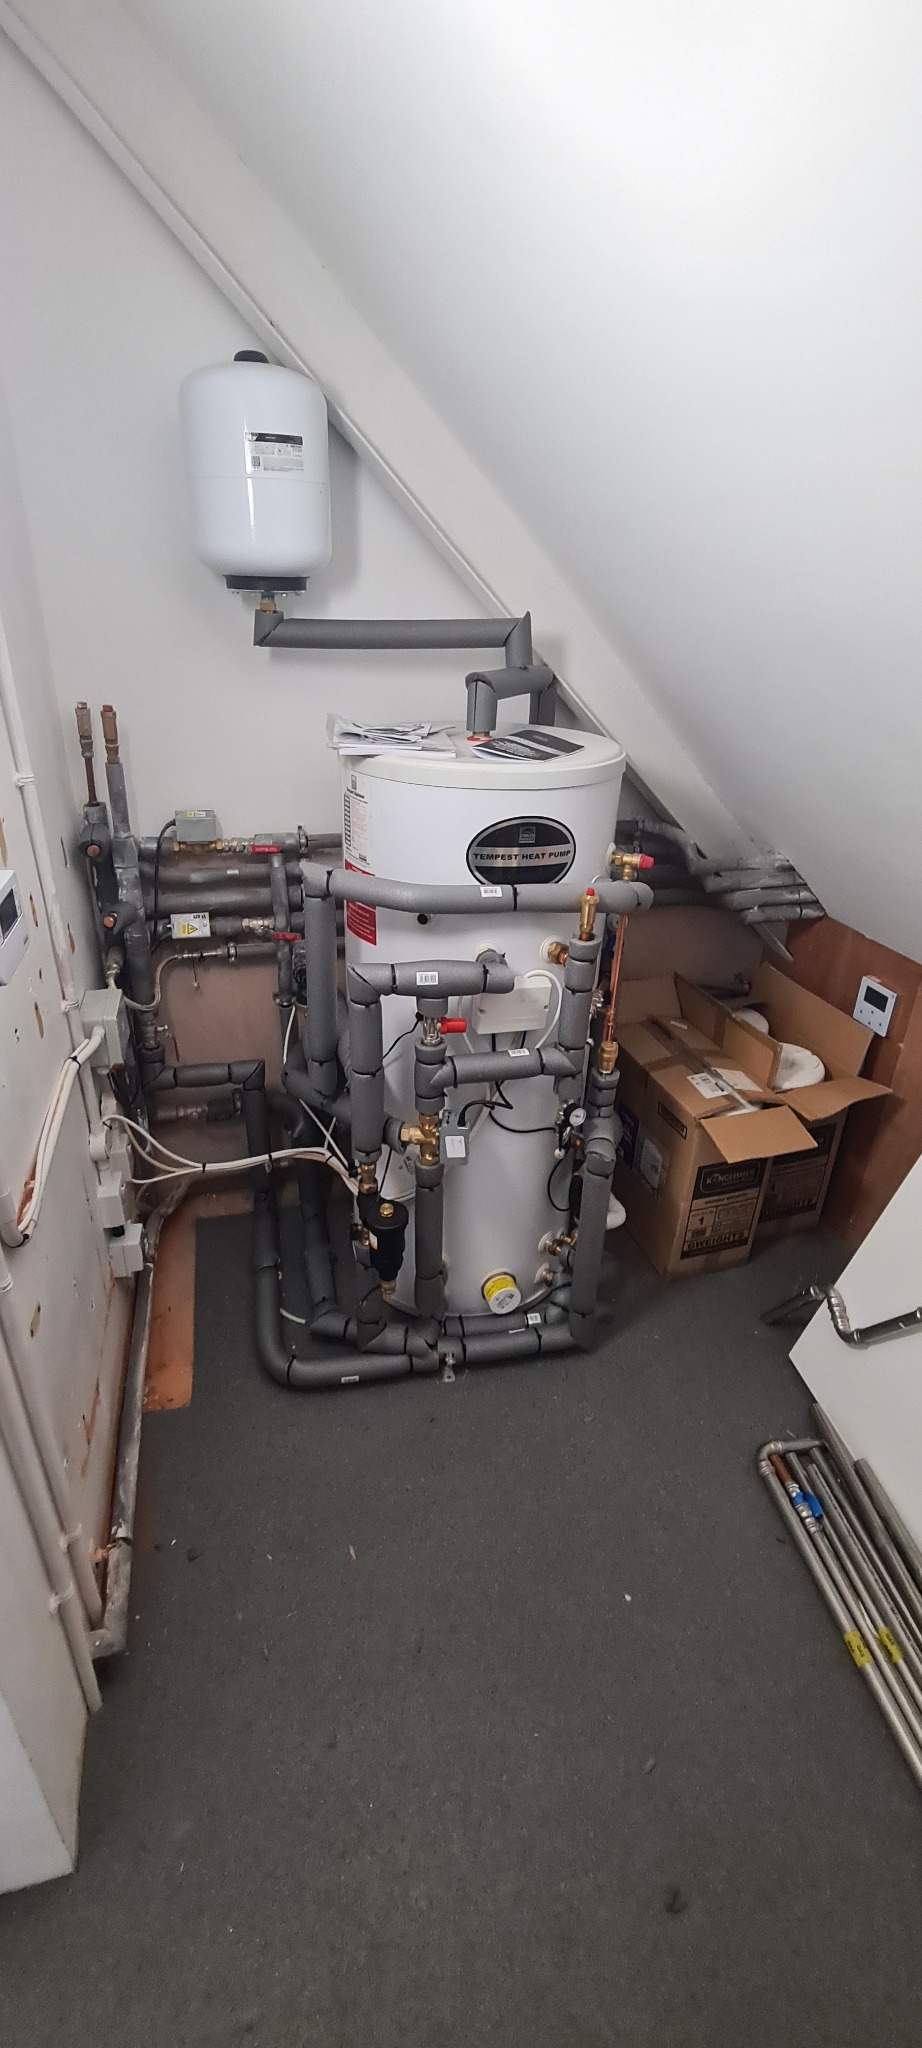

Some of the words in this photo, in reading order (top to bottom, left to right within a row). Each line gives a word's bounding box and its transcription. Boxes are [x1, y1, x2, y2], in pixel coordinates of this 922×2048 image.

[473, 853, 519, 861] TEMPEST
[522, 852, 546, 860] HEAT
[548, 849, 571, 859] PUMP
[698, 1216, 704, 1226] 1
